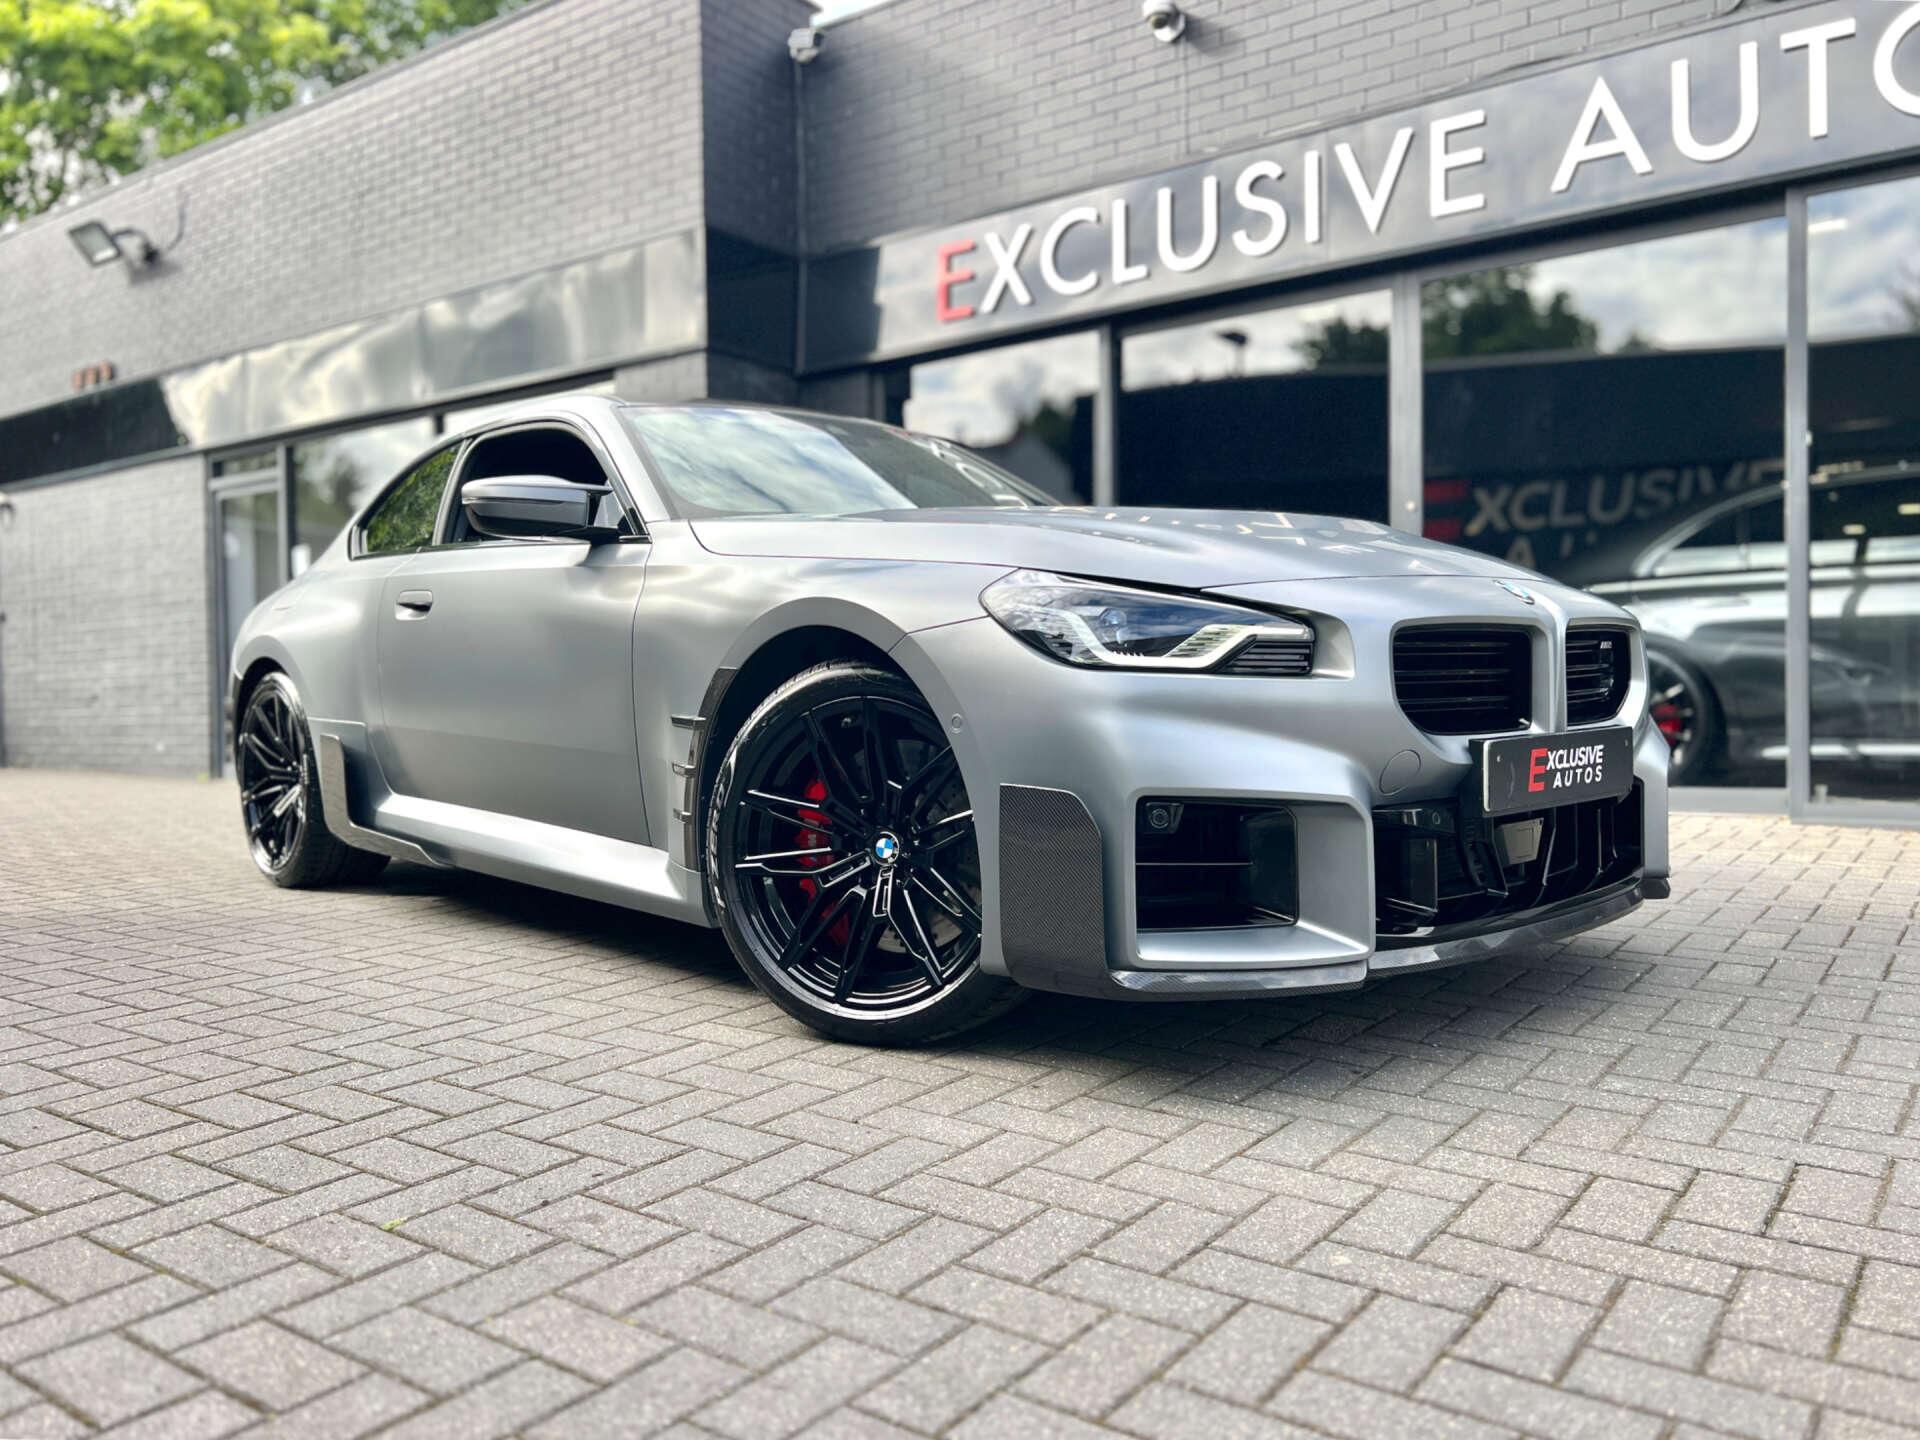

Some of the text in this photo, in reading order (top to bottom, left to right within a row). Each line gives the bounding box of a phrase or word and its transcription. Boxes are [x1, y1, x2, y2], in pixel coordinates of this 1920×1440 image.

[935, 109, 1486, 323] EXCLUSIVE
[1528, 744, 1604, 792] EXCLUSIVE
[1552, 765, 1603, 789] AUTOS
